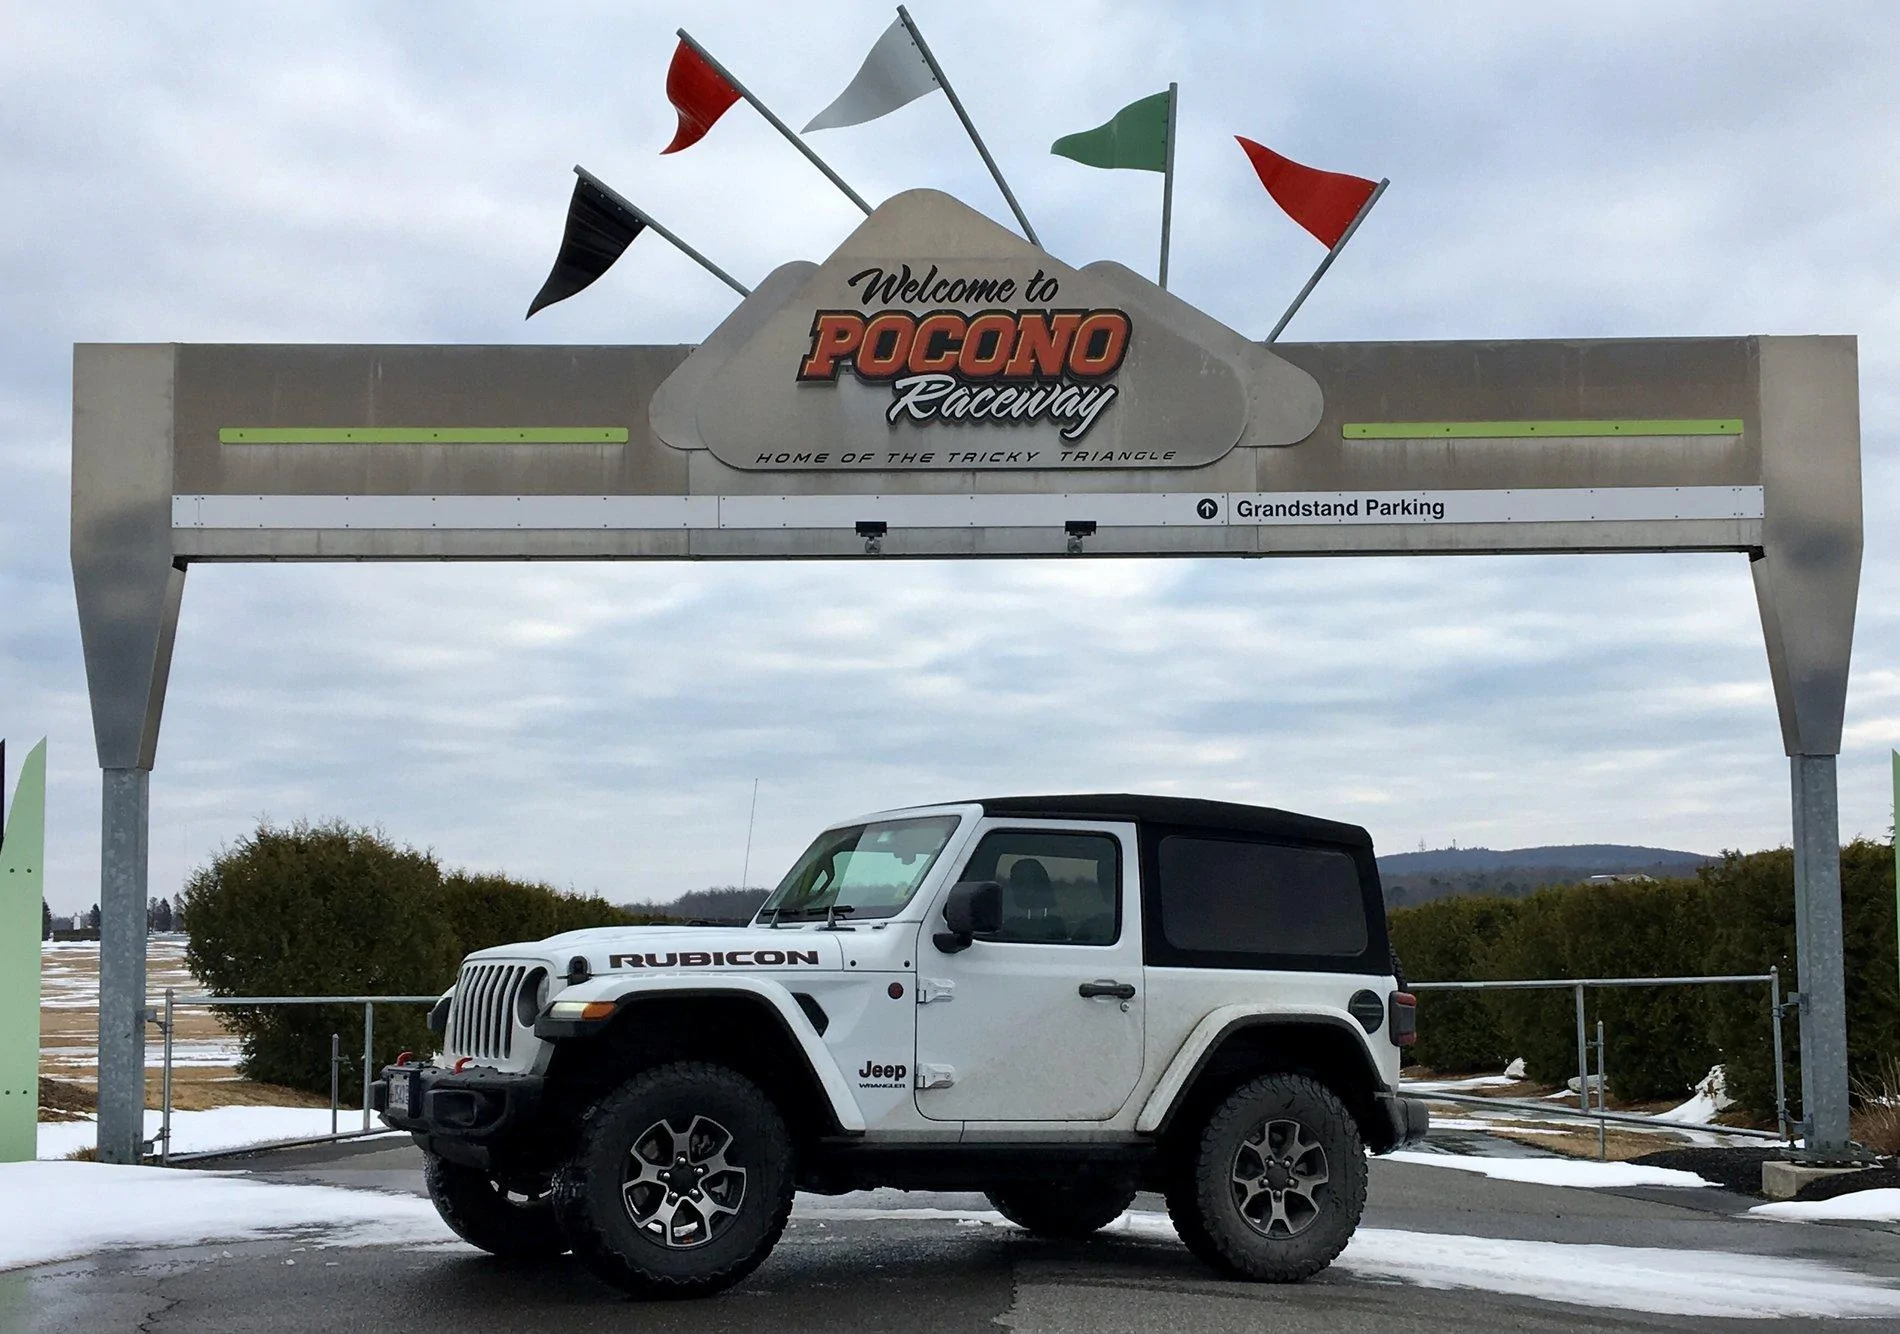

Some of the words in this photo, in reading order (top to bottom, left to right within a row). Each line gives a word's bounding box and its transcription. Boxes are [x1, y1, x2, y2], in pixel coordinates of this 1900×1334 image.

[848, 264, 1017, 306] Welcome
[1025, 269, 1060, 303] to
[798, 309, 1132, 383] POCONO
[888, 373, 1116, 441] Raceway
[755, 451, 830, 464] HOME
[840, 451, 876, 464] OF
[886, 451, 936, 464] THE
[947, 451, 1041, 463] TRICKY
[1059, 450, 1177, 462] TRIANGLE
[1236, 499, 1359, 518] Grandstand
[1366, 498, 1446, 520] Parking
[609, 950, 819, 968] RUBICON
[858, 1060, 907, 1081] Jeep
